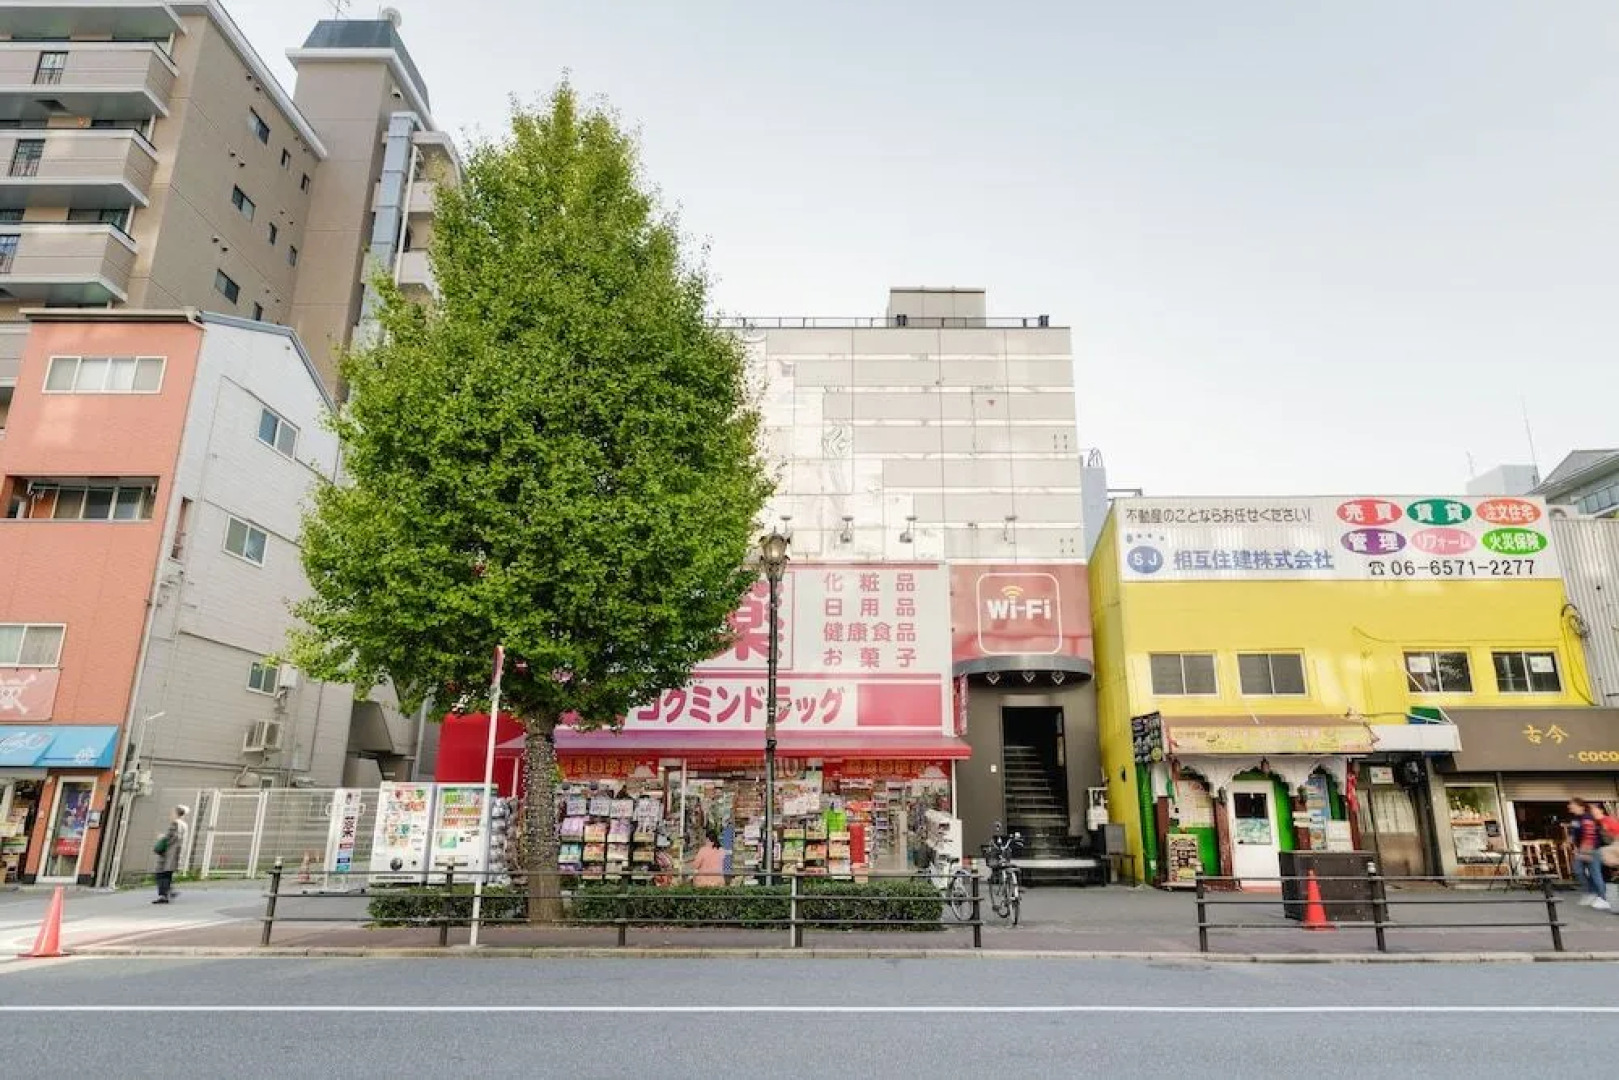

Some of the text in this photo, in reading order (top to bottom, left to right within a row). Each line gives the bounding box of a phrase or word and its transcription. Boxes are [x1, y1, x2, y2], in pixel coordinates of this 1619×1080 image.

[1345, 503, 1395, 521] 売買
[1483, 503, 1536, 522] 注文住宅
[1348, 532, 1400, 551] 管理
[1416, 532, 1471, 550] リフォーム
[1489, 532, 1540, 551] 火災保険
[1173, 549, 1334, 571] 相互住建株式会社
[1391, 559, 1535, 576] 06-6571-2277
[823, 572, 916, 592] 化粧品
[824, 598, 916, 617] 日用品
[986, 597, 1052, 620] Wi-Fi
[823, 621, 917, 642] 健康食品
[823, 647, 917, 668] お菓子
[1521, 724, 1569, 745] 古今
